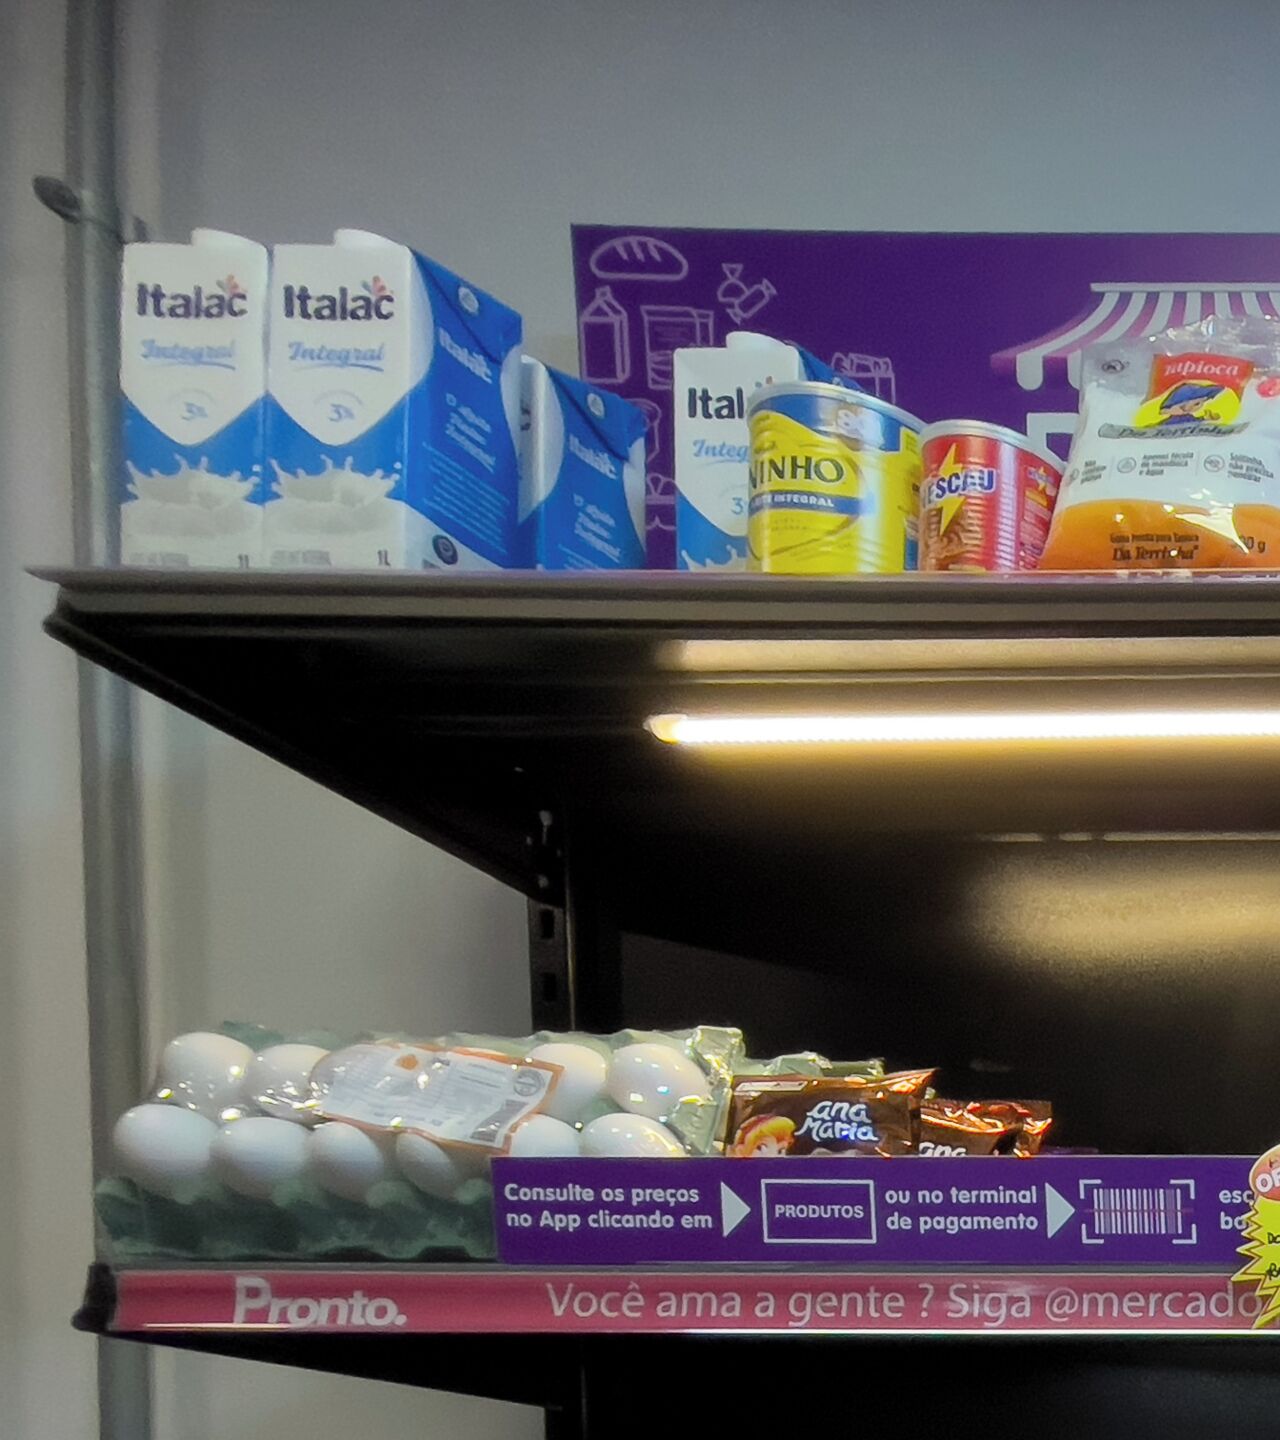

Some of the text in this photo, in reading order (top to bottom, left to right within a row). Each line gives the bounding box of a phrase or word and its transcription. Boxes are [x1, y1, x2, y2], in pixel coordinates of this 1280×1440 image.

[136, 283, 248, 319] Italac
[284, 283, 394, 321] Italac
[504, 1182, 700, 1208] Consulte os preços
[885, 1184, 1037, 1204] ou no terminal
[506, 1208, 713, 1233] no App clicando em
[774, 1203, 865, 1220] PRODUTOS
[886, 1212, 1039, 1235] de pagamento
[233, 1276, 407, 1327] Pronto.
[546, 1281, 645, 1318] Você
[655, 1289, 740, 1317] ama
[754, 1291, 776, 1317] a
[787, 1285, 906, 1326] gente
[919, 1284, 933, 1318] ?
[946, 1284, 1034, 1327] Siga
